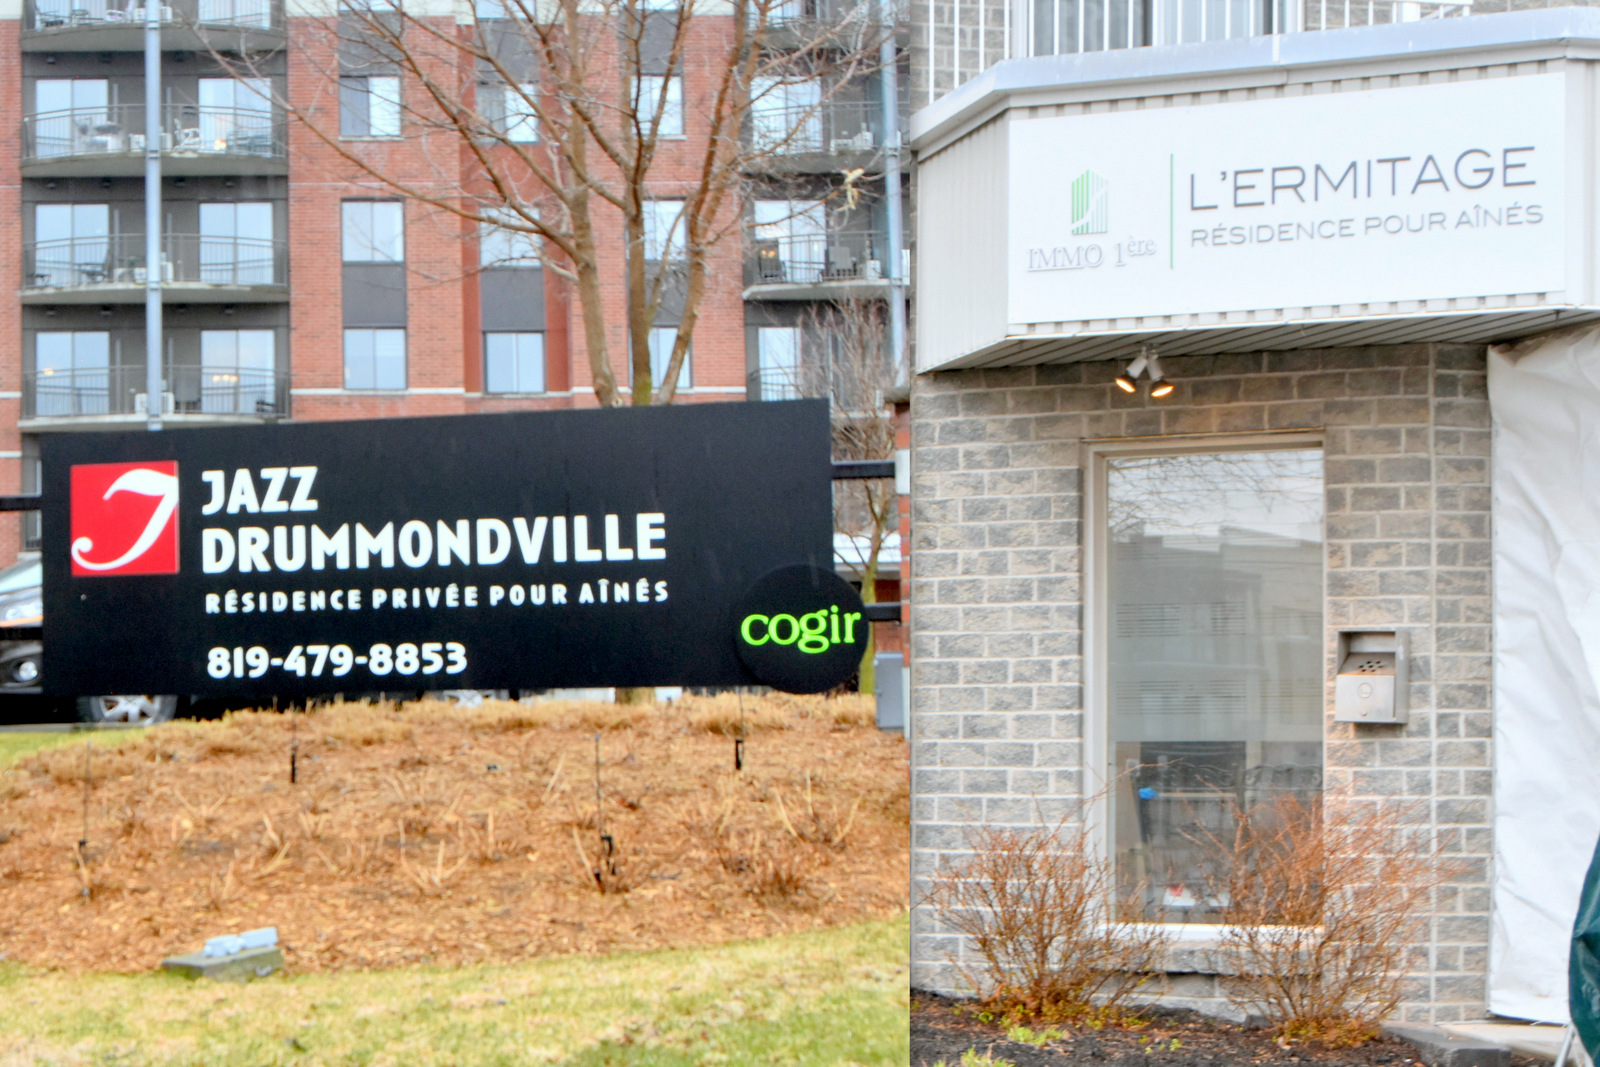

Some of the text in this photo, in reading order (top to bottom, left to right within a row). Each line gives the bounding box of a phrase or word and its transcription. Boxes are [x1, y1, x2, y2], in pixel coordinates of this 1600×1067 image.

[1191, 202, 1544, 248] RÉSIDENCE POUR AÎNÉS
[1027, 243, 1104, 271] IMMO
[201, 465, 319, 515] JAZZ
[202, 512, 667, 574] DRUMMONDVILLE
[205, 577, 669, 614] RÉSIDENCE PRIVÉE POUR AÎNÉS
[741, 605, 862, 654] cogir
[207, 641, 468, 679] 819-479-8853
